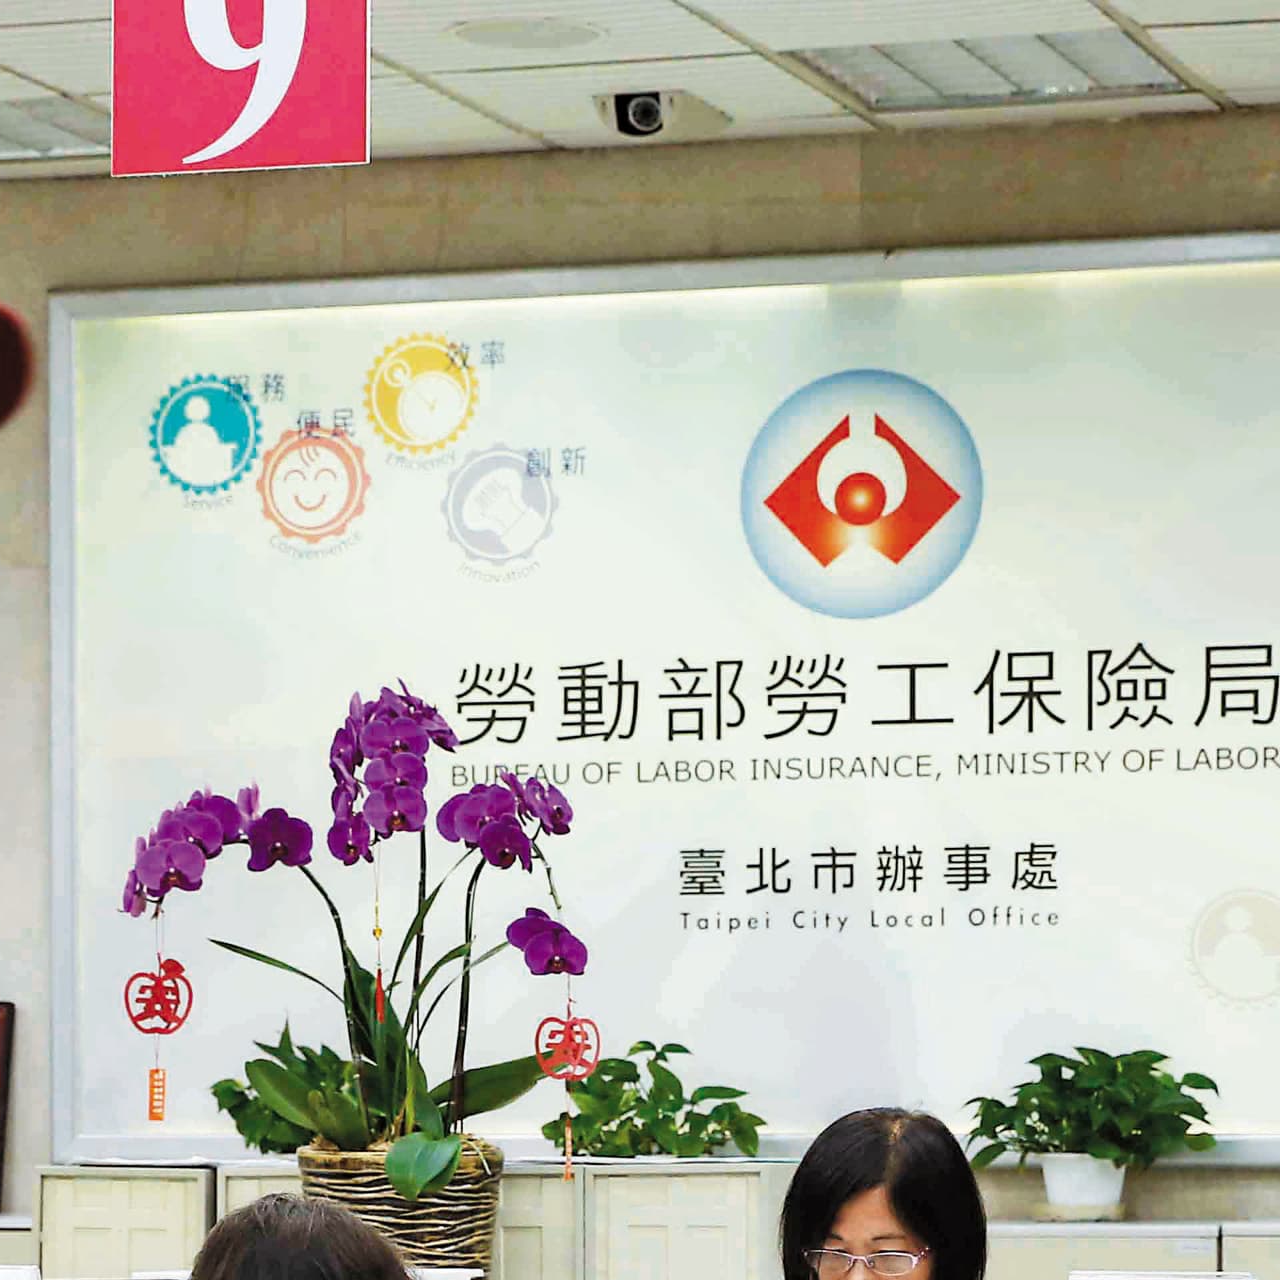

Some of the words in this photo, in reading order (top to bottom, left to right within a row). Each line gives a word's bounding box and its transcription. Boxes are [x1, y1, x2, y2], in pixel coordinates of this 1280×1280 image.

[182, 0, 307, 164] 9
[296, 408, 355, 438] 便民
[526, 447, 586, 478] 創新
[454, 642, 1280, 746] 勞動部勞工保險局
[581, 761, 623, 785] OF
[636, 758, 737, 784] LABOR
[751, 753, 942, 783] INSURANCE,
[957, 750, 1111, 776] MINISTRY
[1122, 748, 1165, 773] OF
[679, 842, 1059, 896] 臺北市辦事處
[680, 911, 771, 934] Taipei
[792, 910, 848, 932] City
[870, 907, 946, 929] Local
[968, 905, 1059, 927] Office
